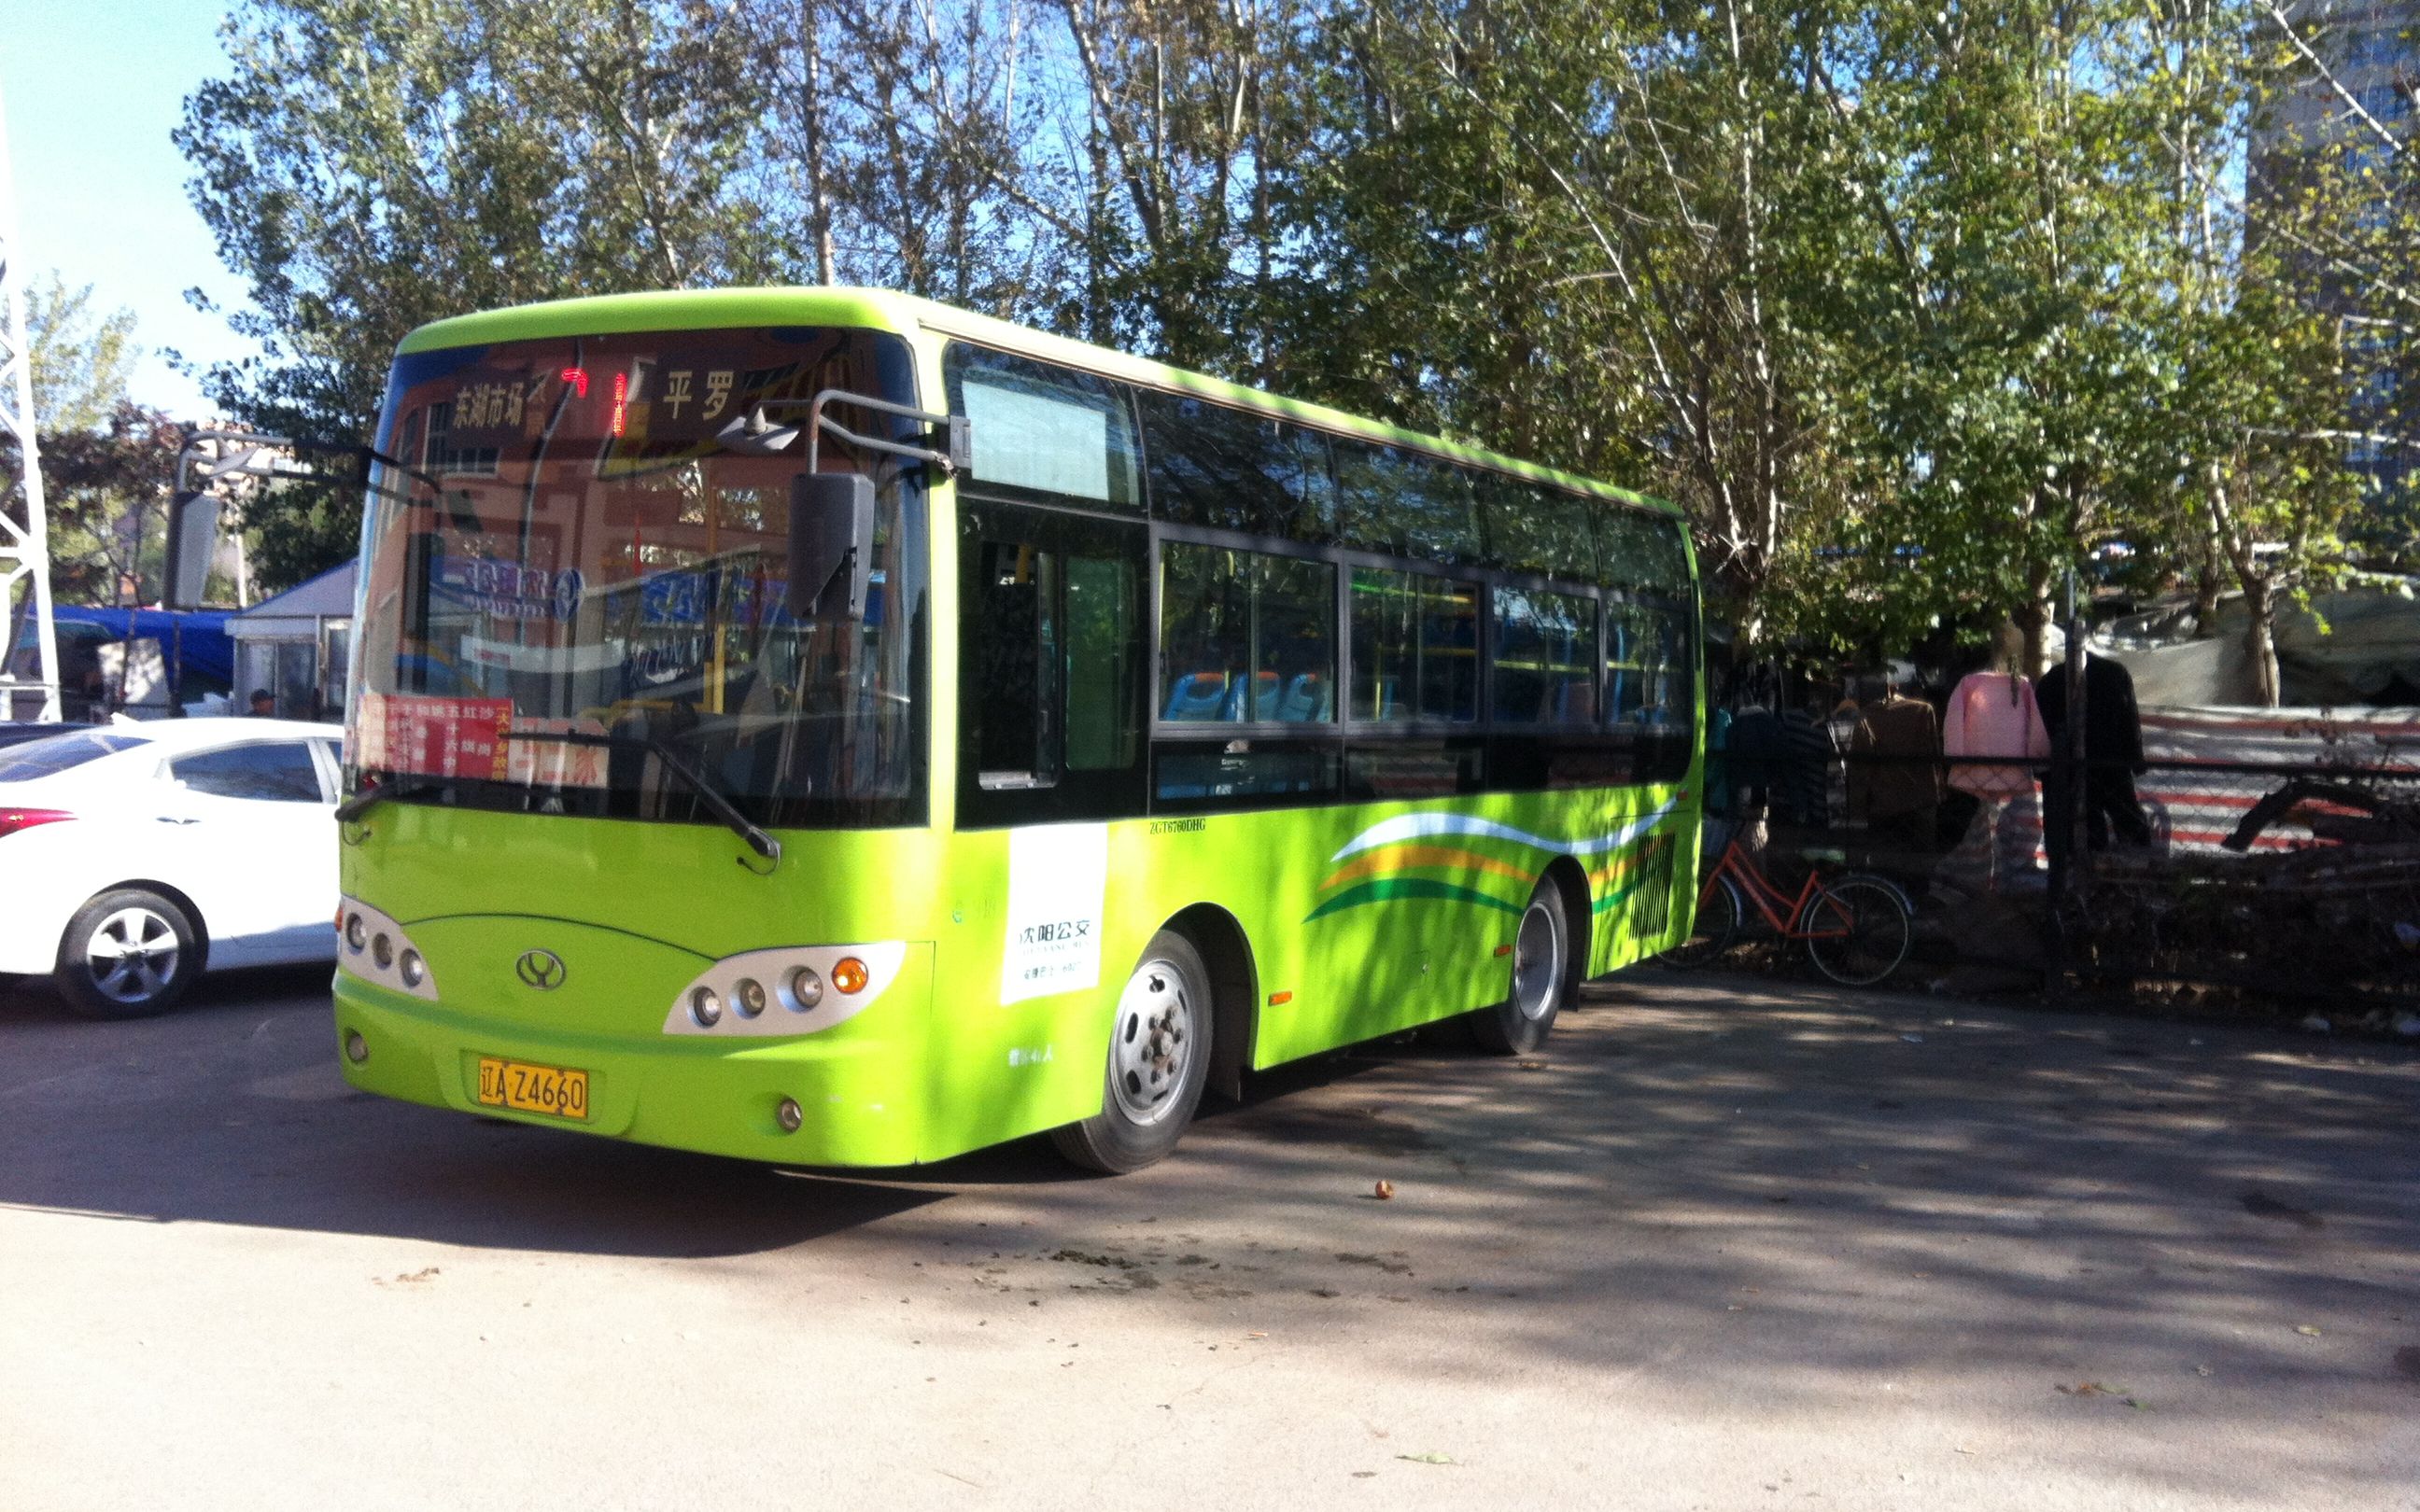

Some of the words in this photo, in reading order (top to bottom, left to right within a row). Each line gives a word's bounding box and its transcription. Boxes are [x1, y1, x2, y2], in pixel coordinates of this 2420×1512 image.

[453, 382, 524, 429] 东湖市场
[663, 370, 735, 421] 平罗
[1020, 919, 1090, 945] 沈阳公交
